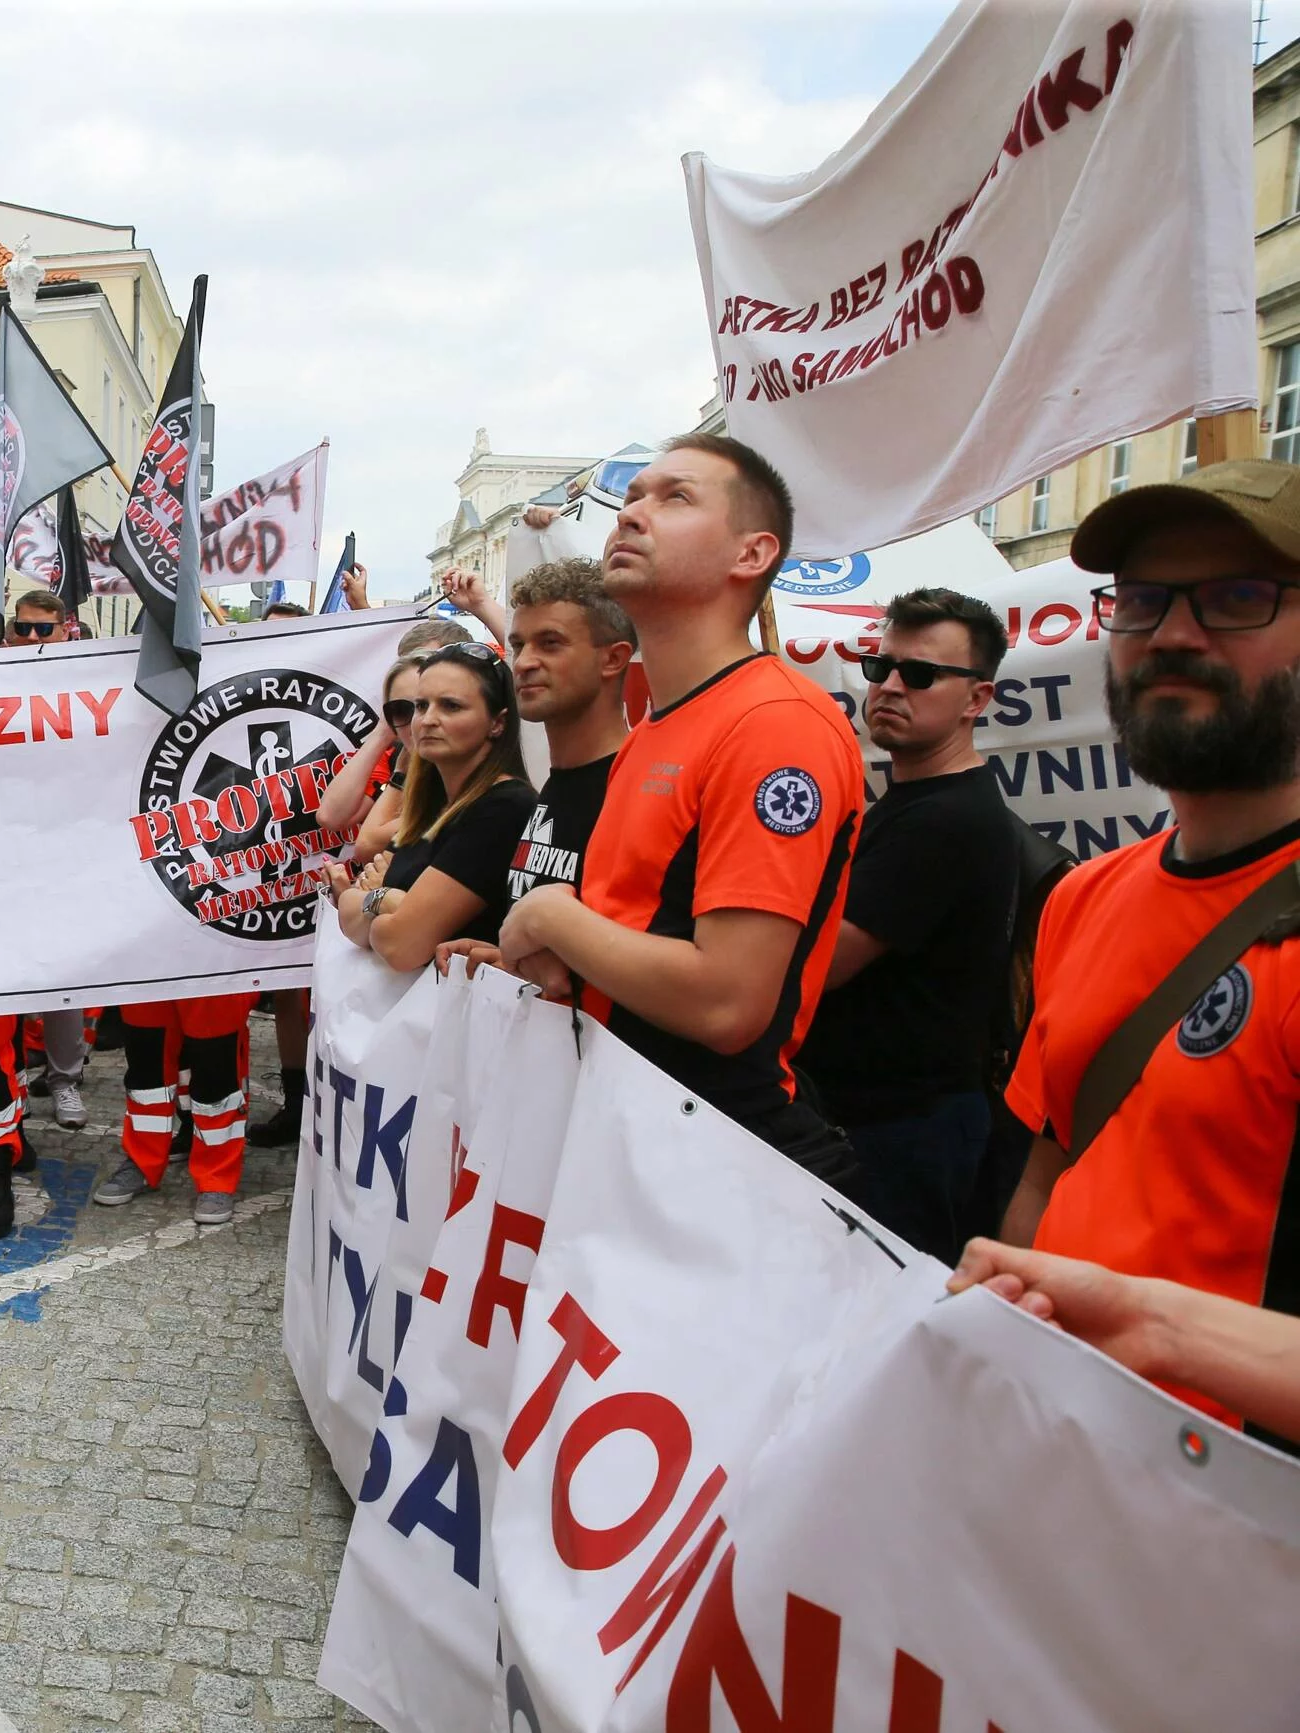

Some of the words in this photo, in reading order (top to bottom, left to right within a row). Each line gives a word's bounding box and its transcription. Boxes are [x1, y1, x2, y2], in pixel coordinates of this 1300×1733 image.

[821, 262, 887, 331] BEZ
[261, 677, 373, 744] RATOW
[764, 817, 807, 834] MEDYCZNE
